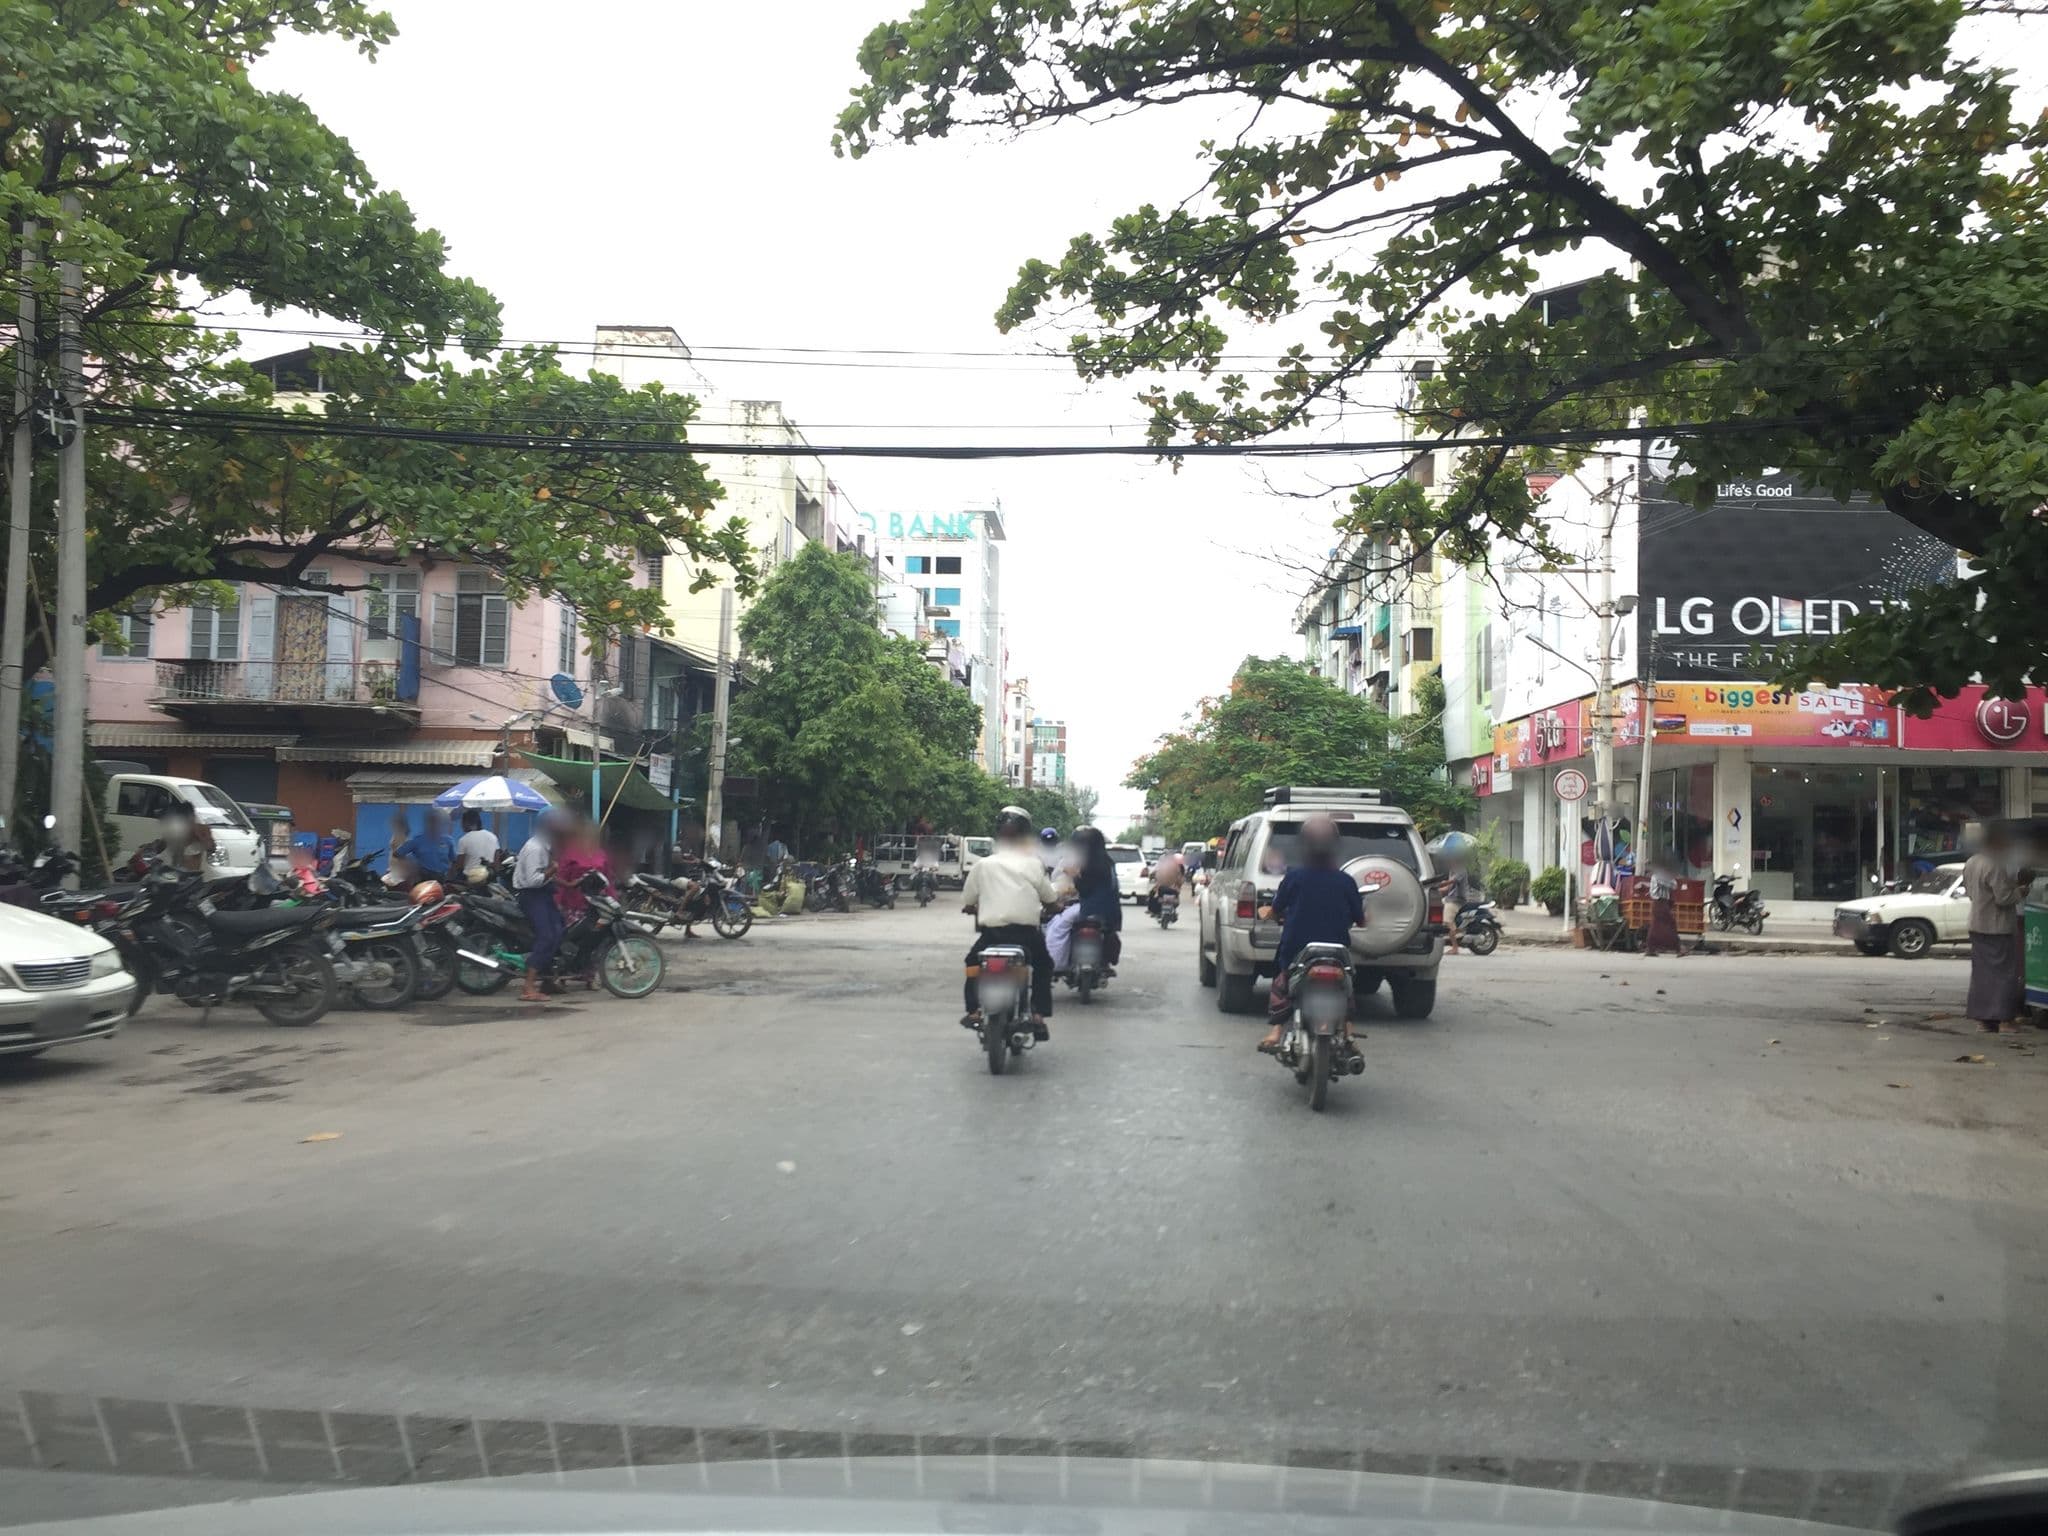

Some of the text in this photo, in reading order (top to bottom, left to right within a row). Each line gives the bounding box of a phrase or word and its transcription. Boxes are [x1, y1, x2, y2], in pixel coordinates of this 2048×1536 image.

[1716, 484, 1793, 497] Life's Good
[889, 512, 976, 540] BANK
[1656, 597, 1714, 635] LG
[1673, 652, 1719, 668] THE
[1660, 688, 1676, 698] LG
[1705, 687, 1792, 709] biggest
[1800, 695, 1860, 710] SALE
